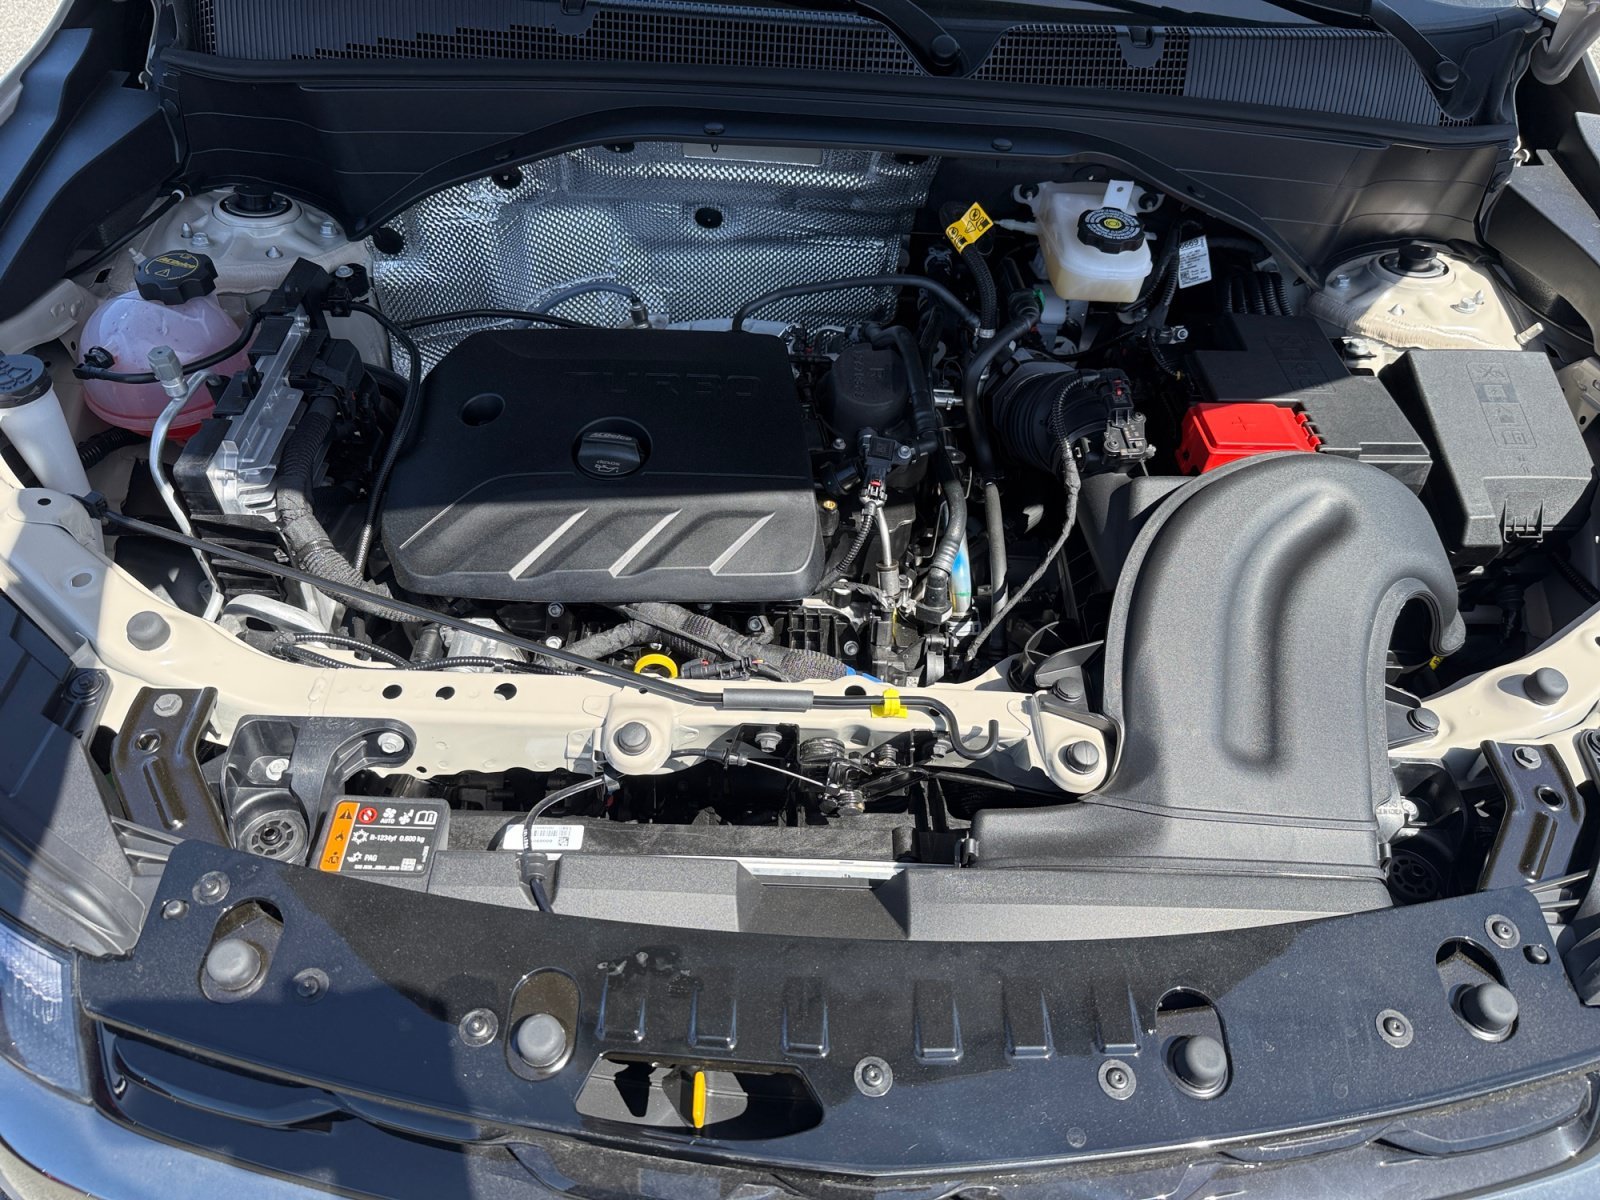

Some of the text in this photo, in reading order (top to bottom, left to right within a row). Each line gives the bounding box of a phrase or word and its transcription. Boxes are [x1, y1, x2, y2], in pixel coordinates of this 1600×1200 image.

[156, 257, 196, 269] ACDelco
[563, 371, 762, 397] TURBO
[589, 432, 633, 441] ACDelco
[417, 836, 426, 844] kg
[364, 854, 378, 862] PAG
